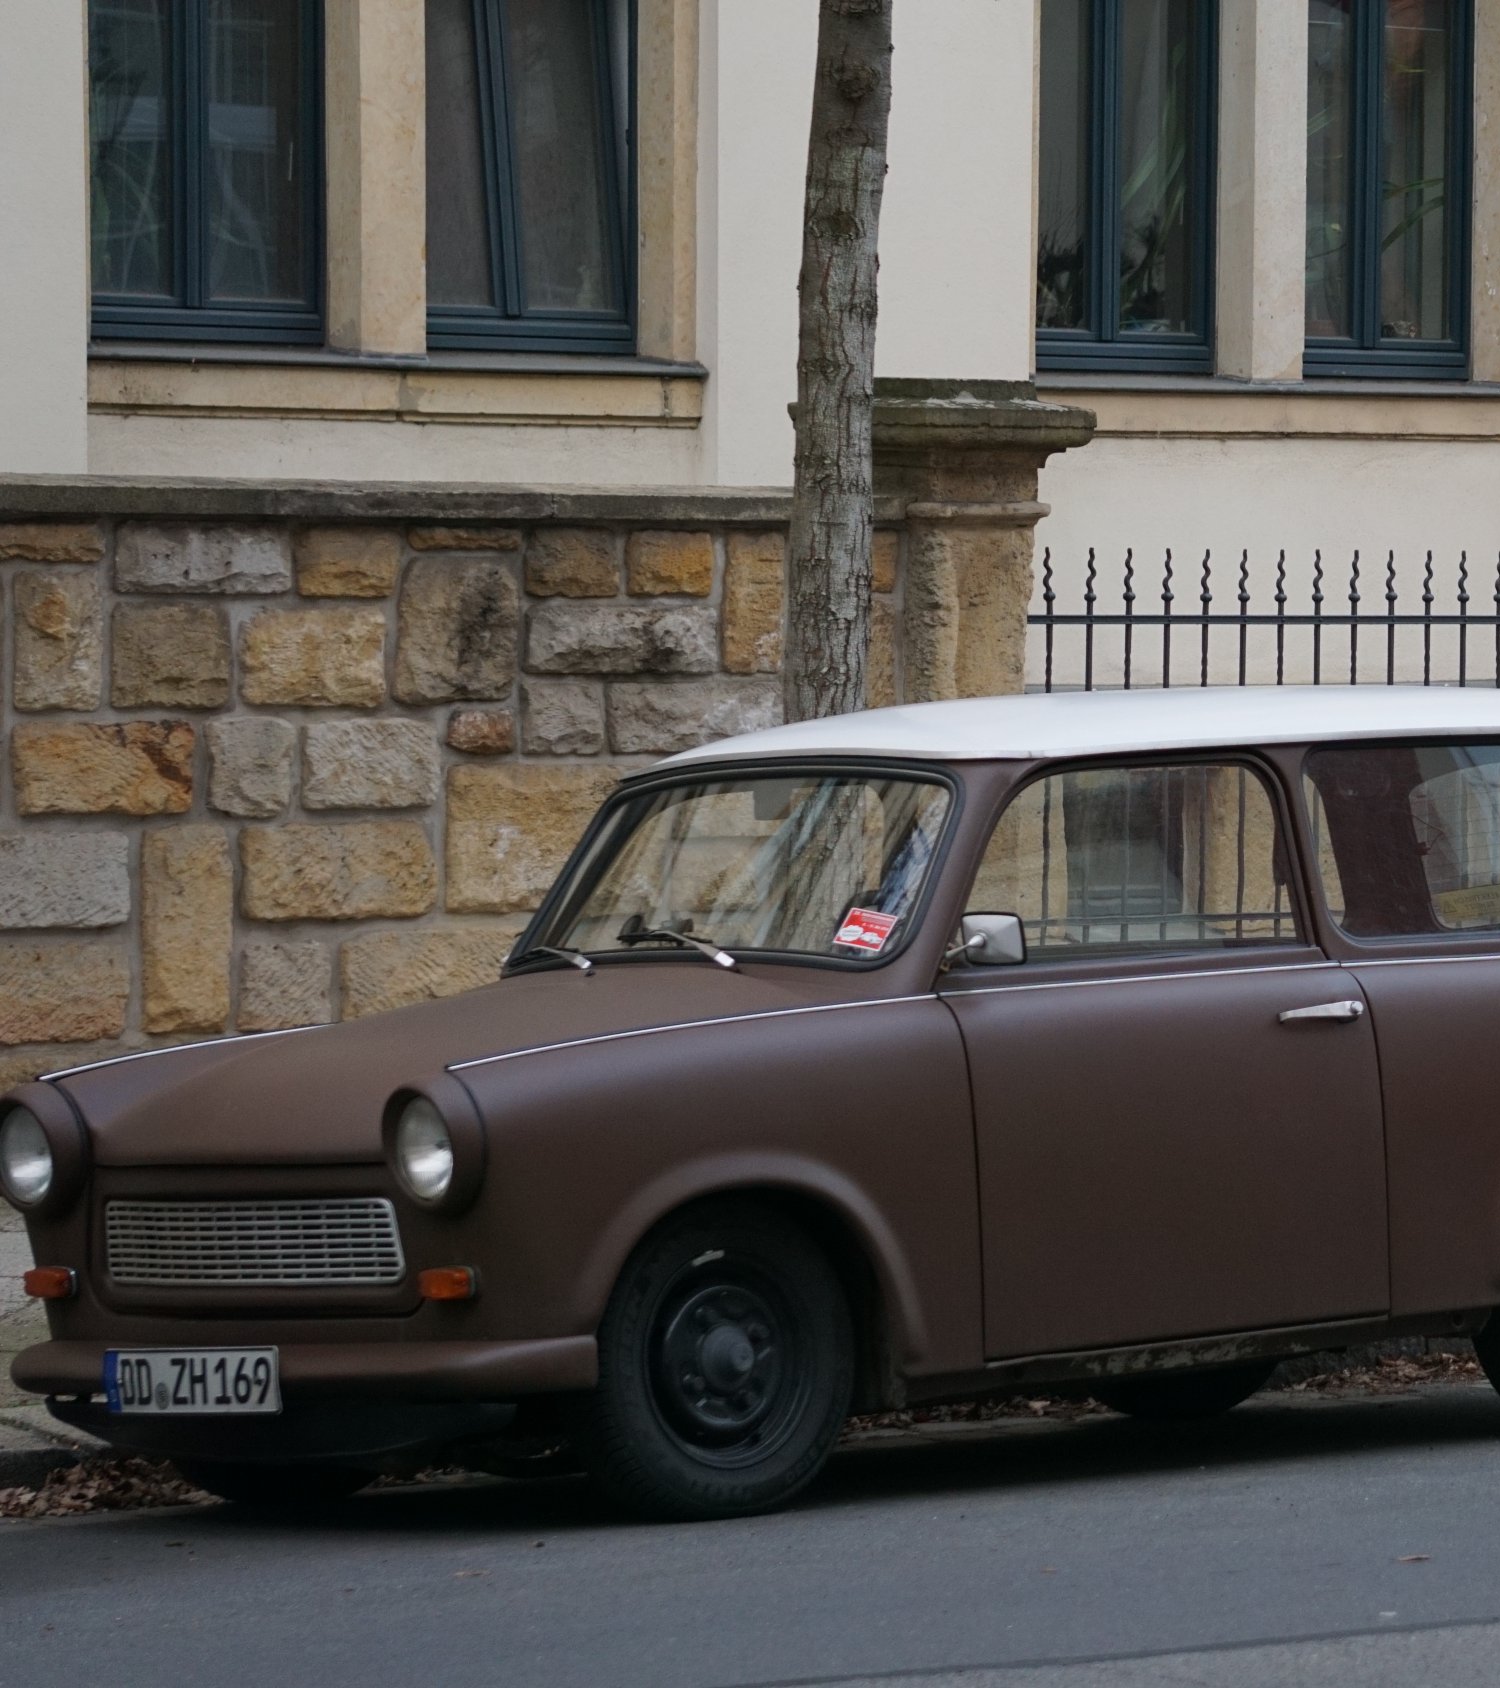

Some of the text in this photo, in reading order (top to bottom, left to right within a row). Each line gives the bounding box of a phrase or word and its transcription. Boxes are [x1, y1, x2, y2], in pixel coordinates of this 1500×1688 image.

[120, 1356, 271, 1405] DD ZH 169
